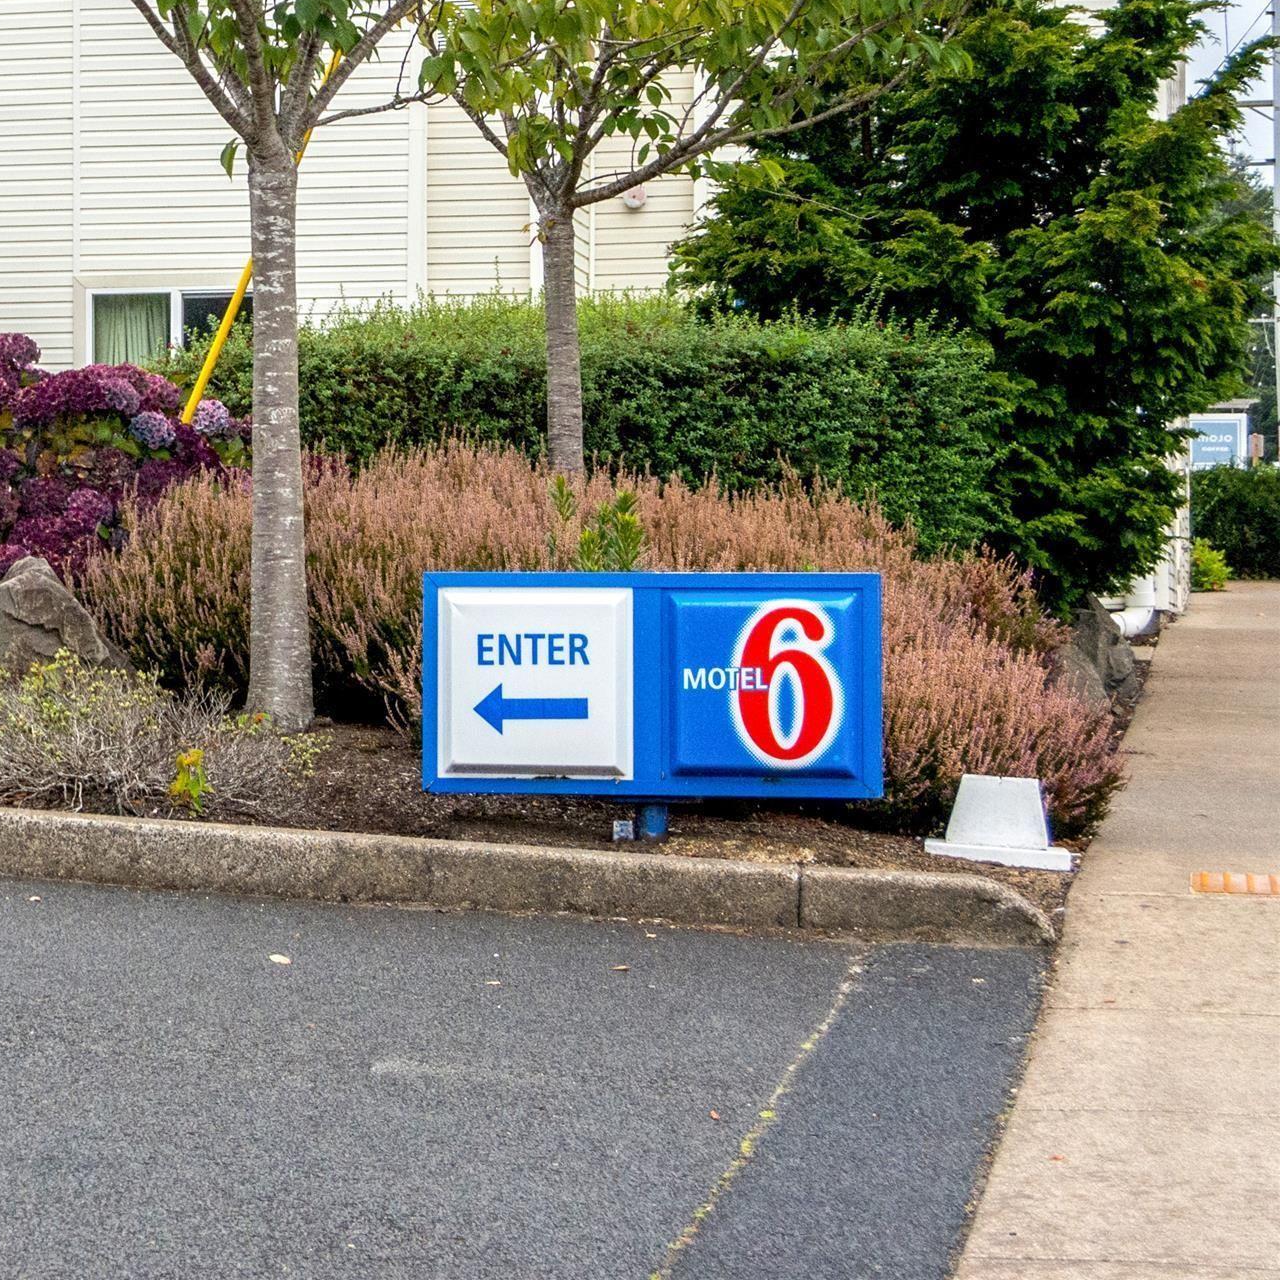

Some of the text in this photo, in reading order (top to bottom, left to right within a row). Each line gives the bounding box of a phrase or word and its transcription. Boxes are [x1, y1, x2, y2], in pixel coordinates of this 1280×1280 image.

[477, 633, 590, 666] ENTER
[683, 607, 833, 760] MOTEL 6
